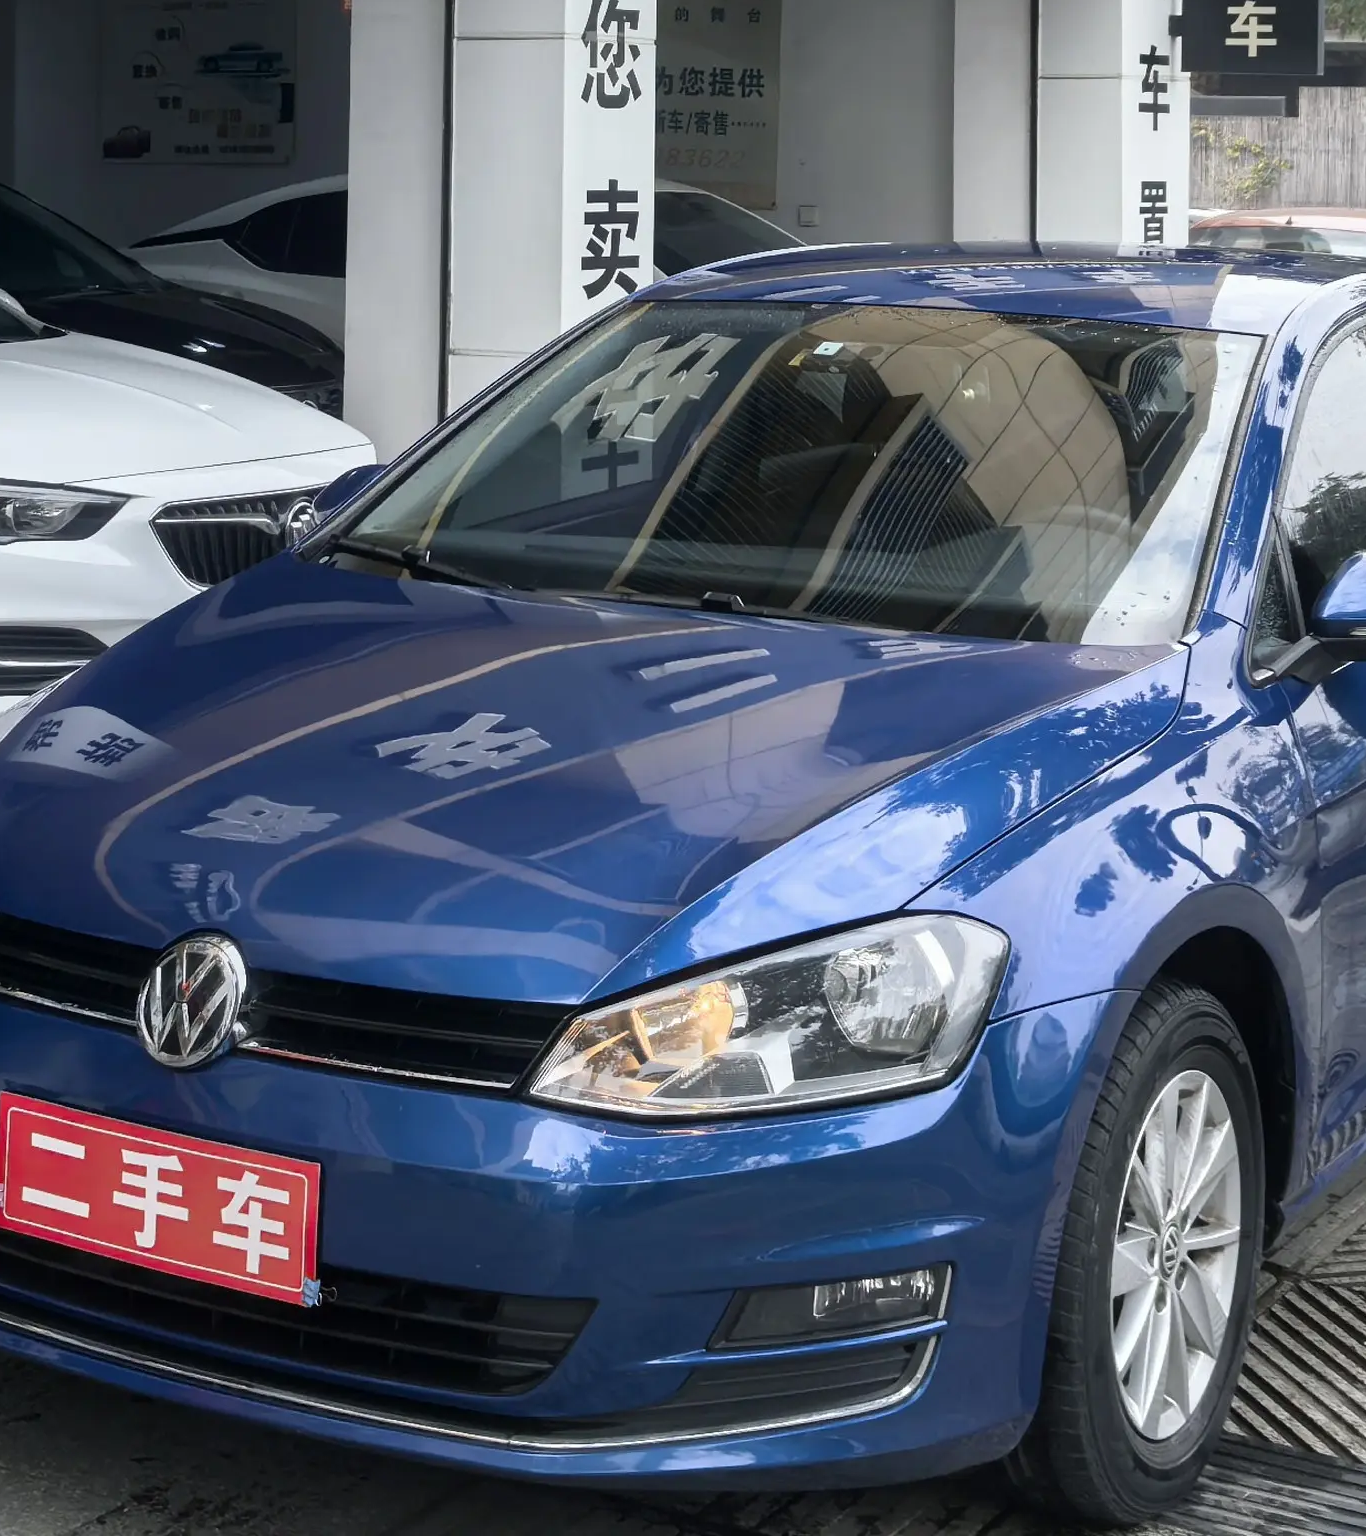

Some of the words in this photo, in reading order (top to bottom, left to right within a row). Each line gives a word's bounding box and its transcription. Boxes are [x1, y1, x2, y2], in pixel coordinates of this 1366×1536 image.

[657, 66, 765, 99] 为您提供
[21, 1131, 291, 1275] 二手车
